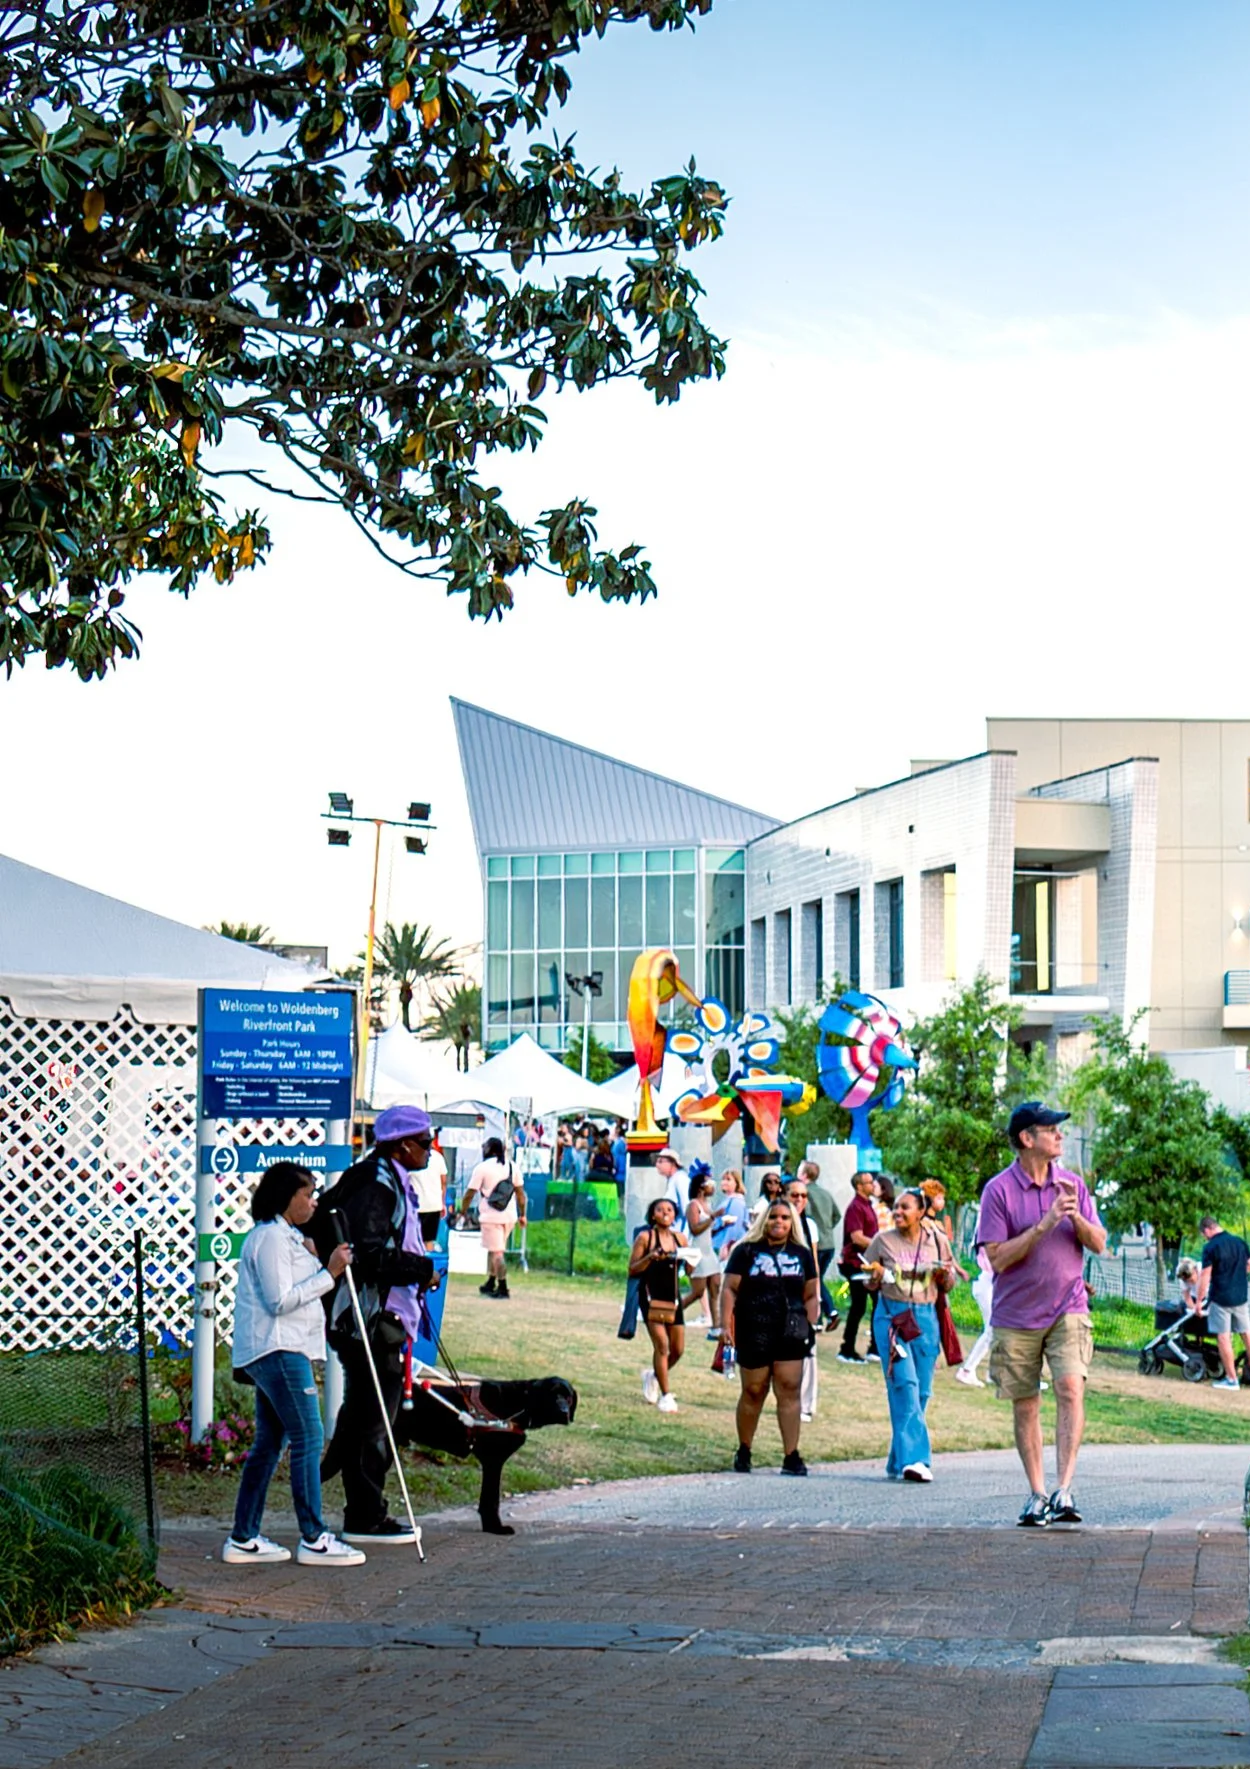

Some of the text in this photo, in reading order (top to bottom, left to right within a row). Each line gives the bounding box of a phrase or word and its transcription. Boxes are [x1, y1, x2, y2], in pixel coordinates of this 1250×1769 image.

[219, 999, 339, 1019] Welcome to Woldenberg
[243, 1018, 316, 1033] Riverfront Park
[262, 1039, 301, 1049] Park Hours
[220, 1048, 247, 1059] Sunday
[253, 1049, 287, 1060] Thursday
[212, 1060, 235, 1072] Friday
[241, 1061, 274, 1073] Saturday
[312, 1062, 344, 1073] Midnight
